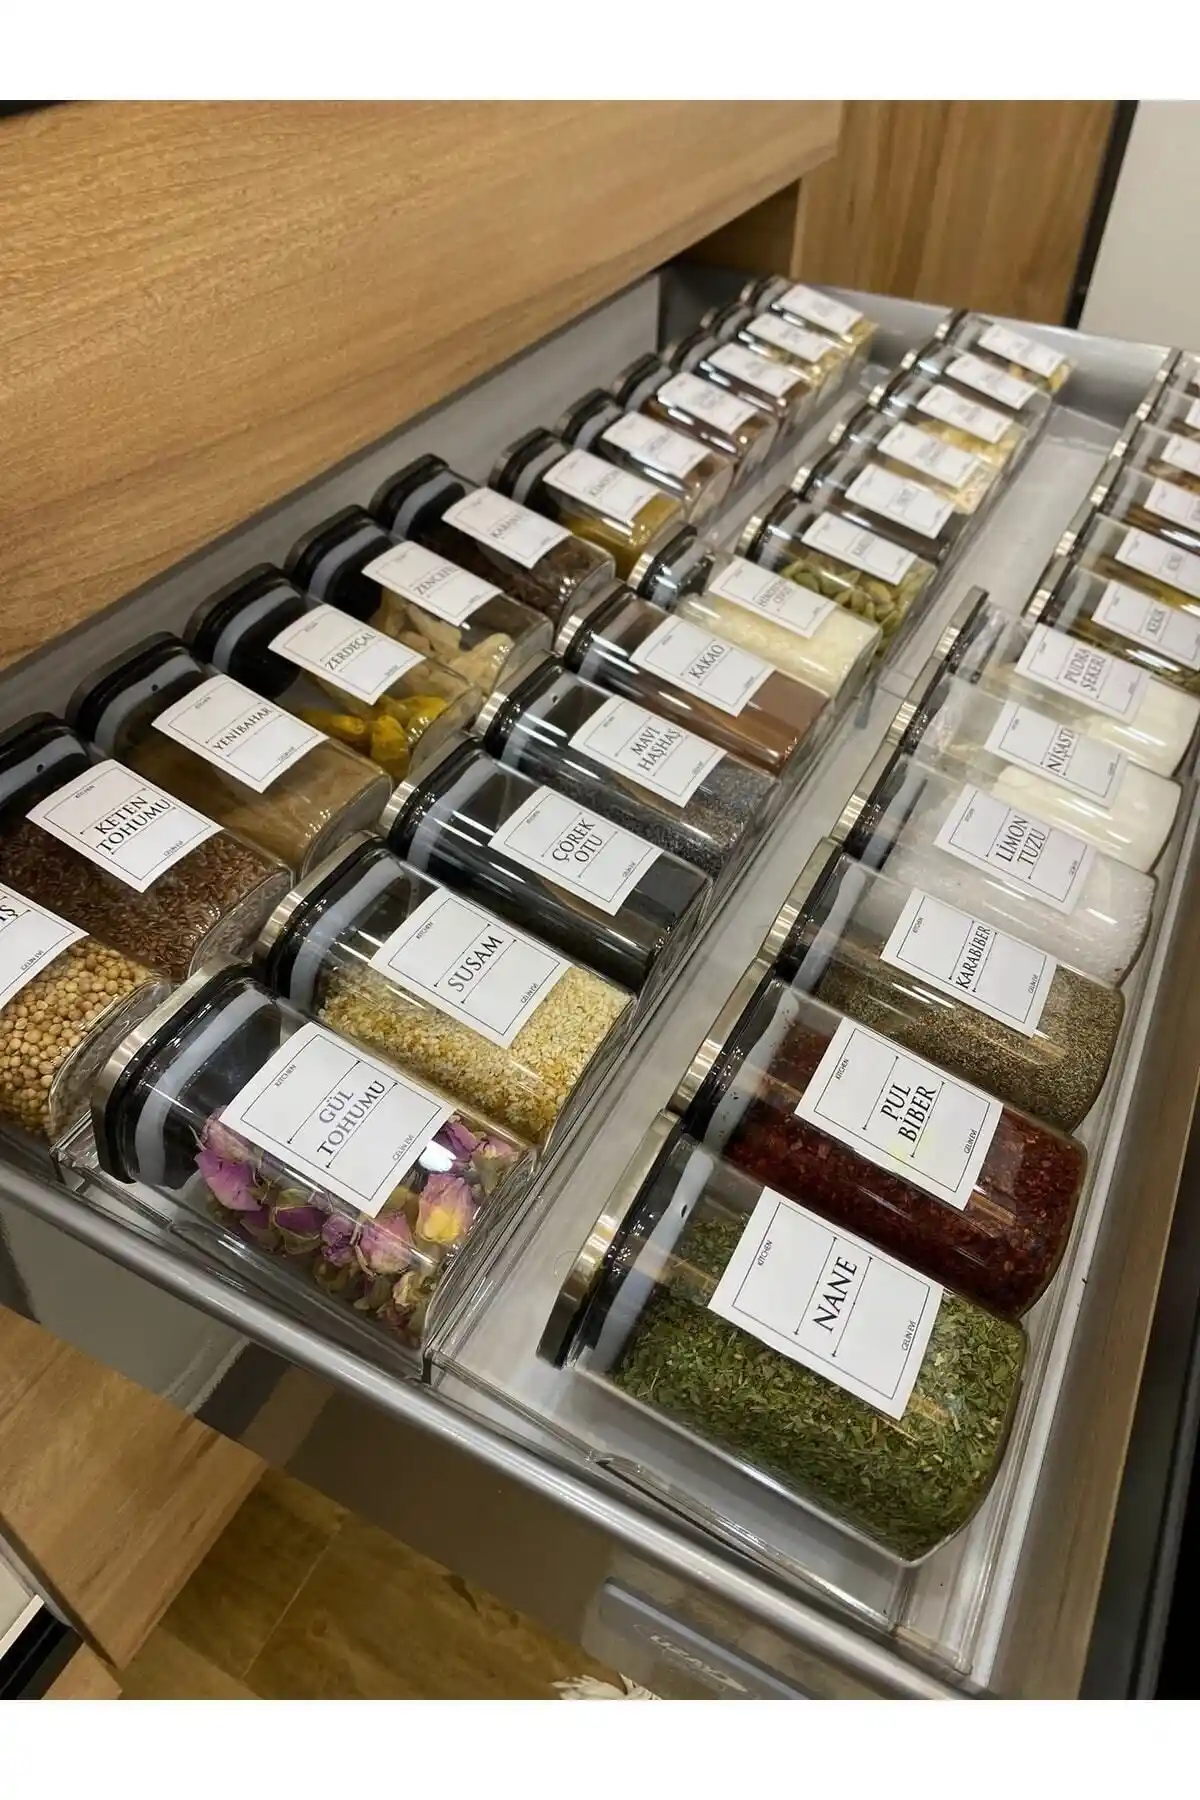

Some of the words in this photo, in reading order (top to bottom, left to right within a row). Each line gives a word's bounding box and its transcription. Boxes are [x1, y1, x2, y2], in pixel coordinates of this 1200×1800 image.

[325, 630, 377, 671] ZERDEÇAL
[688, 644, 725, 679] KAKAO
[213, 706, 274, 751] YENİBAHAR
[638, 728, 682, 771] HAŞHAŞ
[1047, 728, 1075, 773] NİŞAST
[94, 796, 149, 837] KETEN
[96, 798, 173, 854] TOHUMU
[552, 819, 596, 864] ÇÖREK
[574, 834, 604, 863] OTU
[995, 815, 1029, 863] LİMON
[1017, 828, 1047, 866] TUZU
[447, 935, 504, 992] SUSAM
[955, 925, 992, 989] KARABİBER
[835, 1058, 850, 1081] KITCHEN
[317, 1080, 386, 1156] TOHUMU
[319, 1091, 354, 1124] GÜL
[880, 1083, 912, 1122] PUL
[898, 1085, 937, 1143] BİBER
[757, 1239, 773, 1266] KITCHEN
[812, 1256, 858, 1332] NANE
